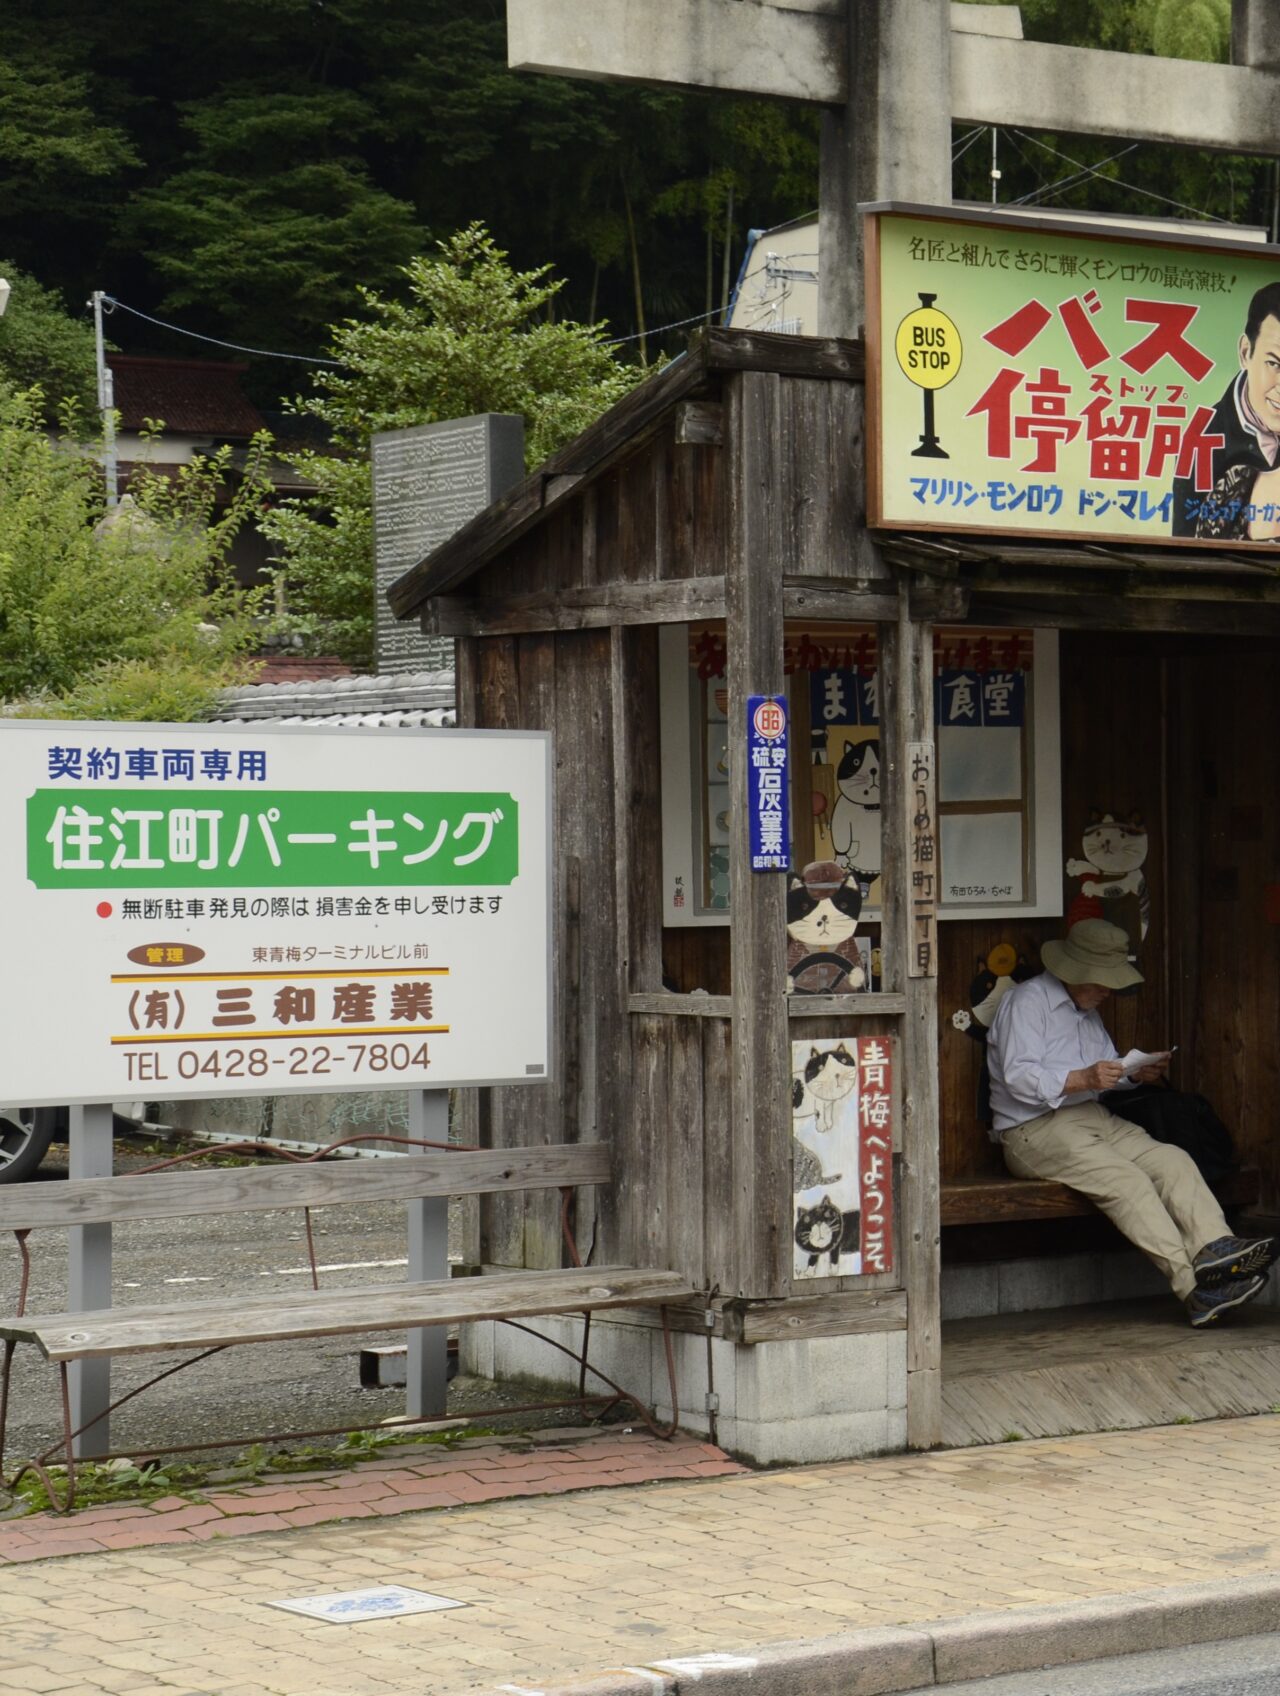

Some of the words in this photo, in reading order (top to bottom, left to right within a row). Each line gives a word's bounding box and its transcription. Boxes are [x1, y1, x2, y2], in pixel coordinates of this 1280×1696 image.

[912, 326, 946, 348] BUS
[981, 288, 1216, 382] バス
[907, 350, 951, 371] STOP
[1089, 374, 1189, 403] ストップ
[965, 366, 1225, 492] 停留所
[911, 478, 1063, 515] マリリン・モンロウ
[1079, 489, 1174, 522] ドン・マレイ
[762, 710, 780, 731] 昭
[48, 746, 267, 782] 契約車両専用
[752, 747, 786, 768] 硫安
[759, 768, 783, 854] 石灰窒素
[46, 805, 504, 870] 住江町パーキング
[912, 753, 935, 972] おうめ猫町一丁目
[146, 947, 184, 963] 管理
[252, 944, 429, 963] 東青梅ターミナルビル前
[124, 1051, 168, 1080] TEL
[178, 1042, 431, 1078] 0428-22-7804
[860, 1040, 890, 1271] 青梅へようこそ
